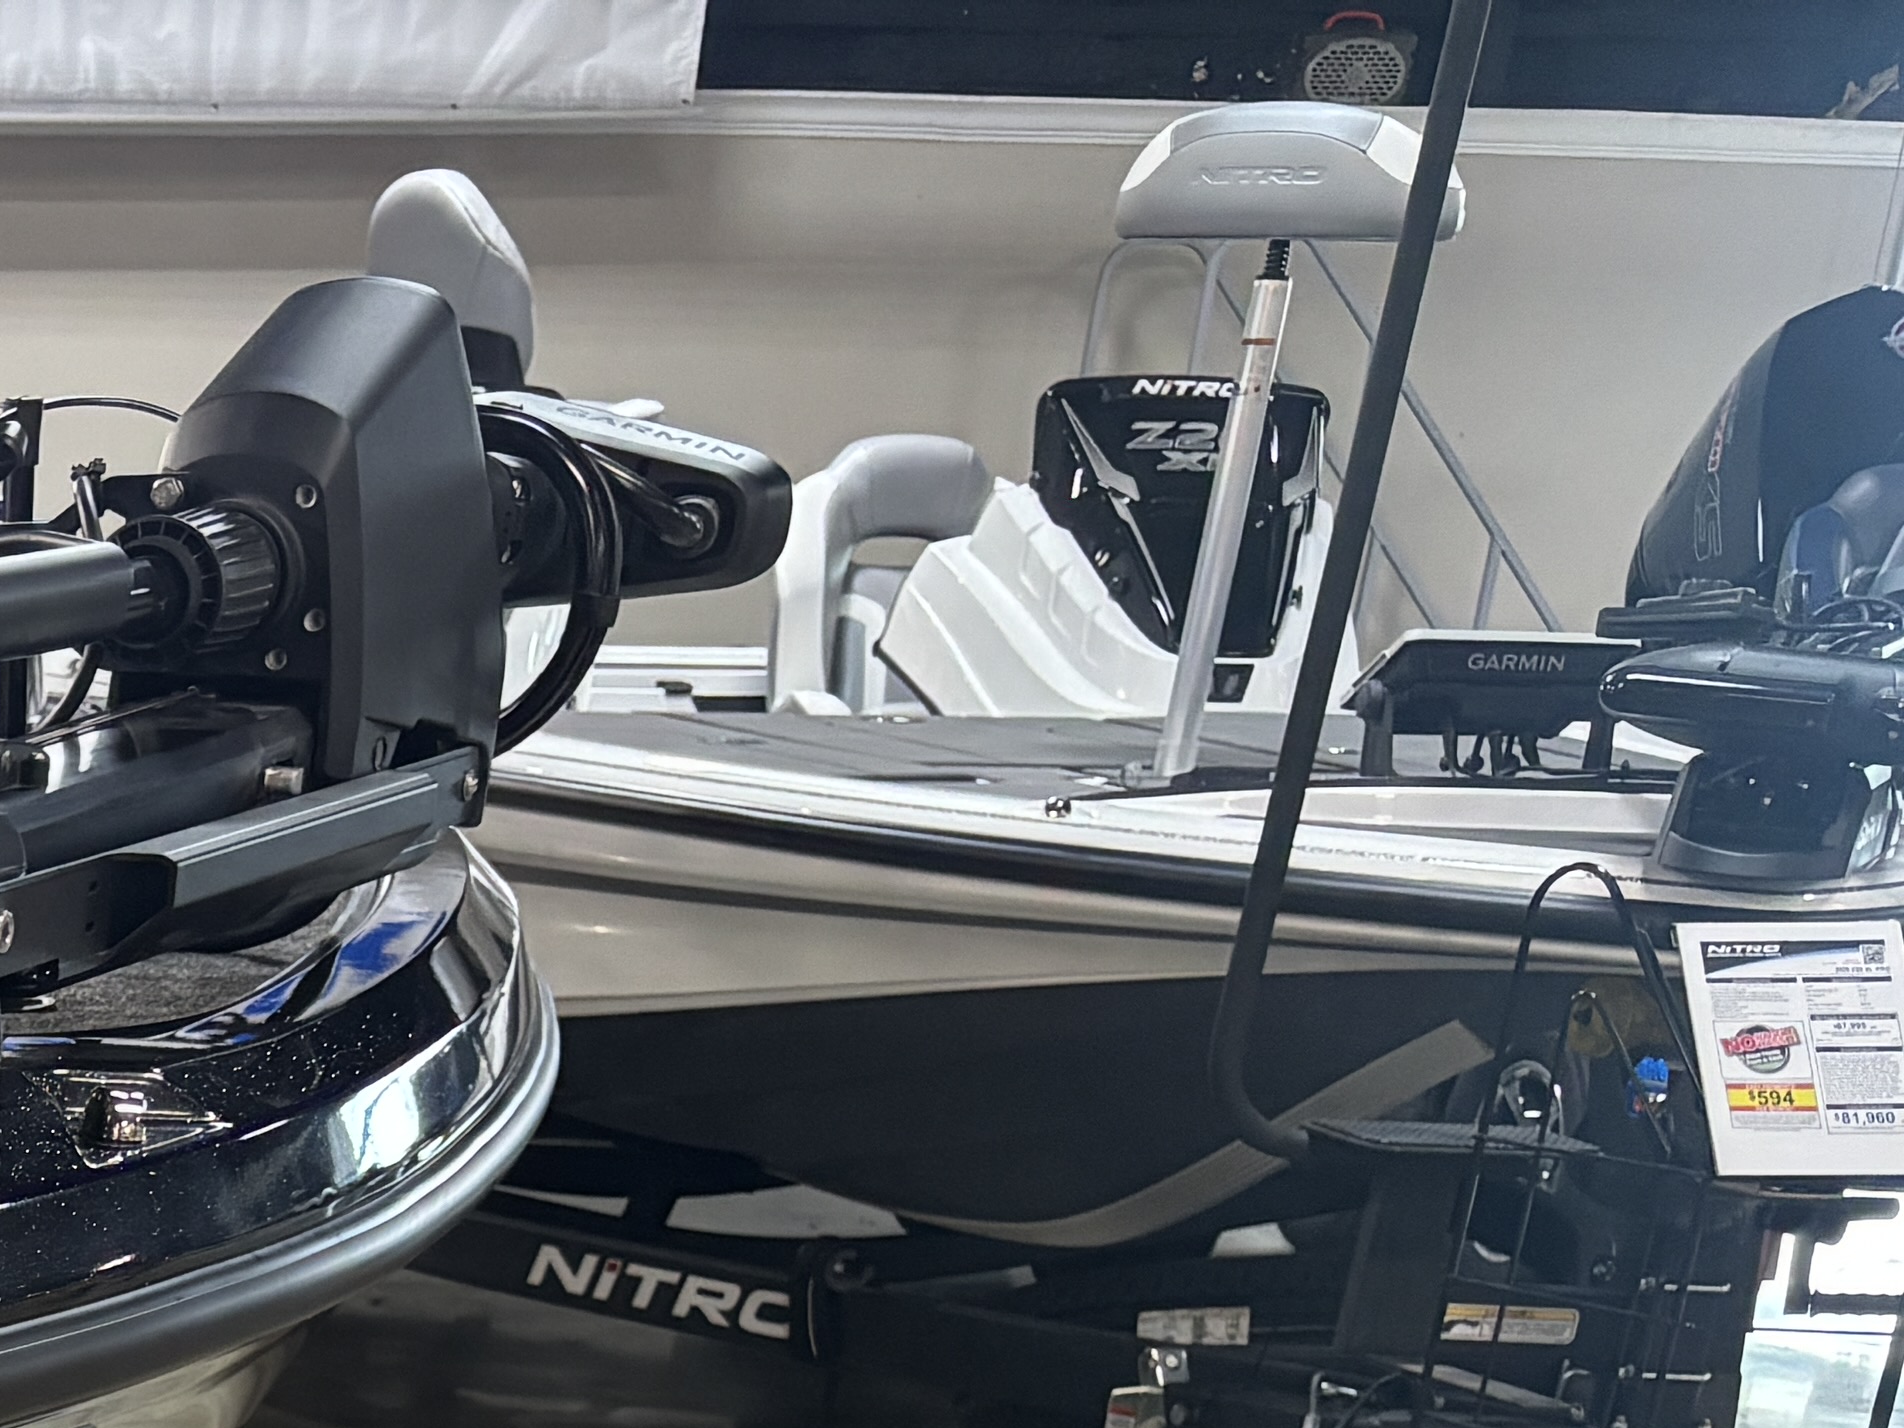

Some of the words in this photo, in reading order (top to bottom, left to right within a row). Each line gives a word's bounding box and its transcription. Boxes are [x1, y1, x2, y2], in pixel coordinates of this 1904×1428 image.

[556, 406, 746, 460] GARMIN
[1125, 421, 1221, 449] Z2
[1156, 450, 1216, 471] X
[1467, 653, 1565, 672] GARMIN
[1748, 1089, 1795, 1106] $594
